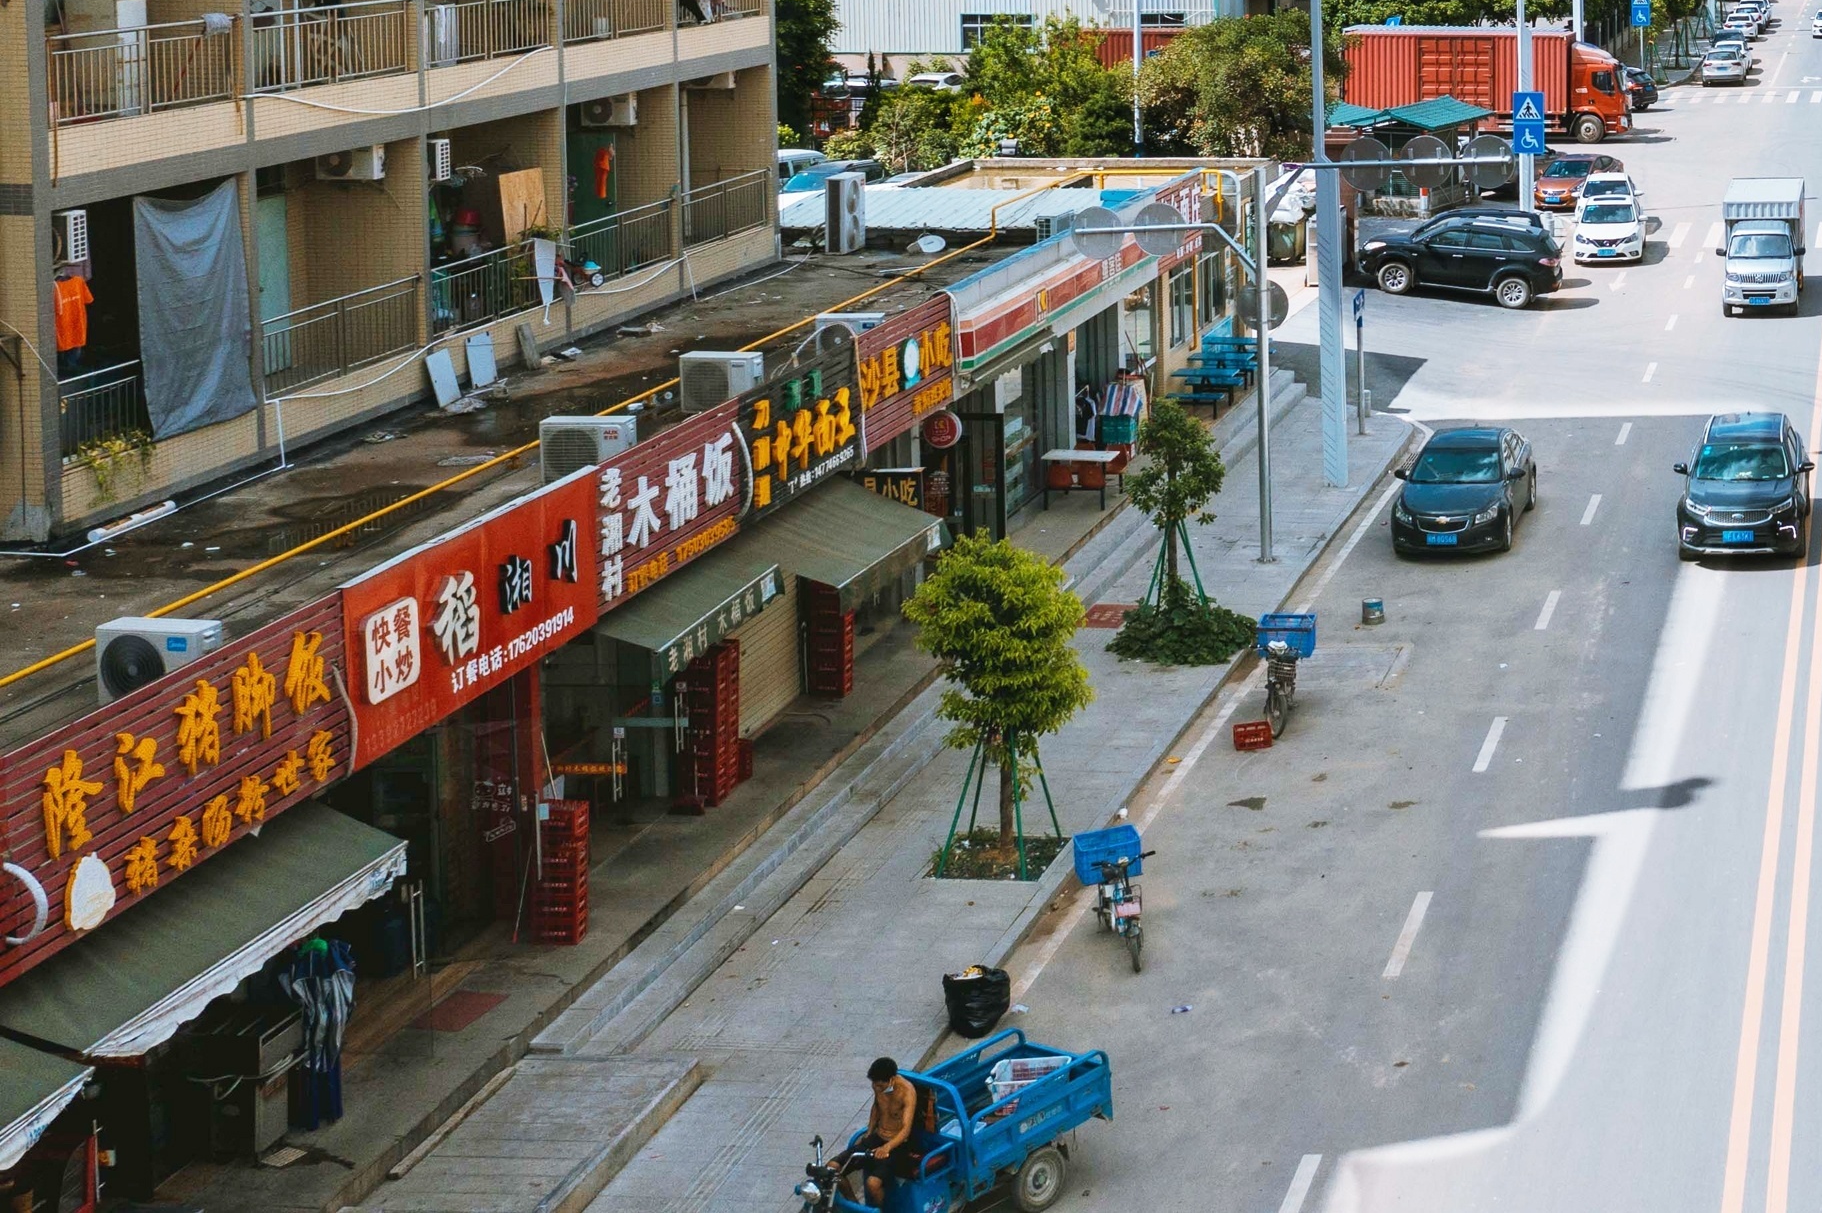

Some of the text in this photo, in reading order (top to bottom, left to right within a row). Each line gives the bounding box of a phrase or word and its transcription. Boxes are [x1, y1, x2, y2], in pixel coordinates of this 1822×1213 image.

[600, 468, 623, 602] 老湘村
[626, 432, 735, 549] 木桶饭
[371, 606, 412, 656] 快餐
[431, 519, 578, 667] 稻湘川
[374, 645, 414, 695] 小炒
[43, 631, 331, 861] 隆江猪脚饭
